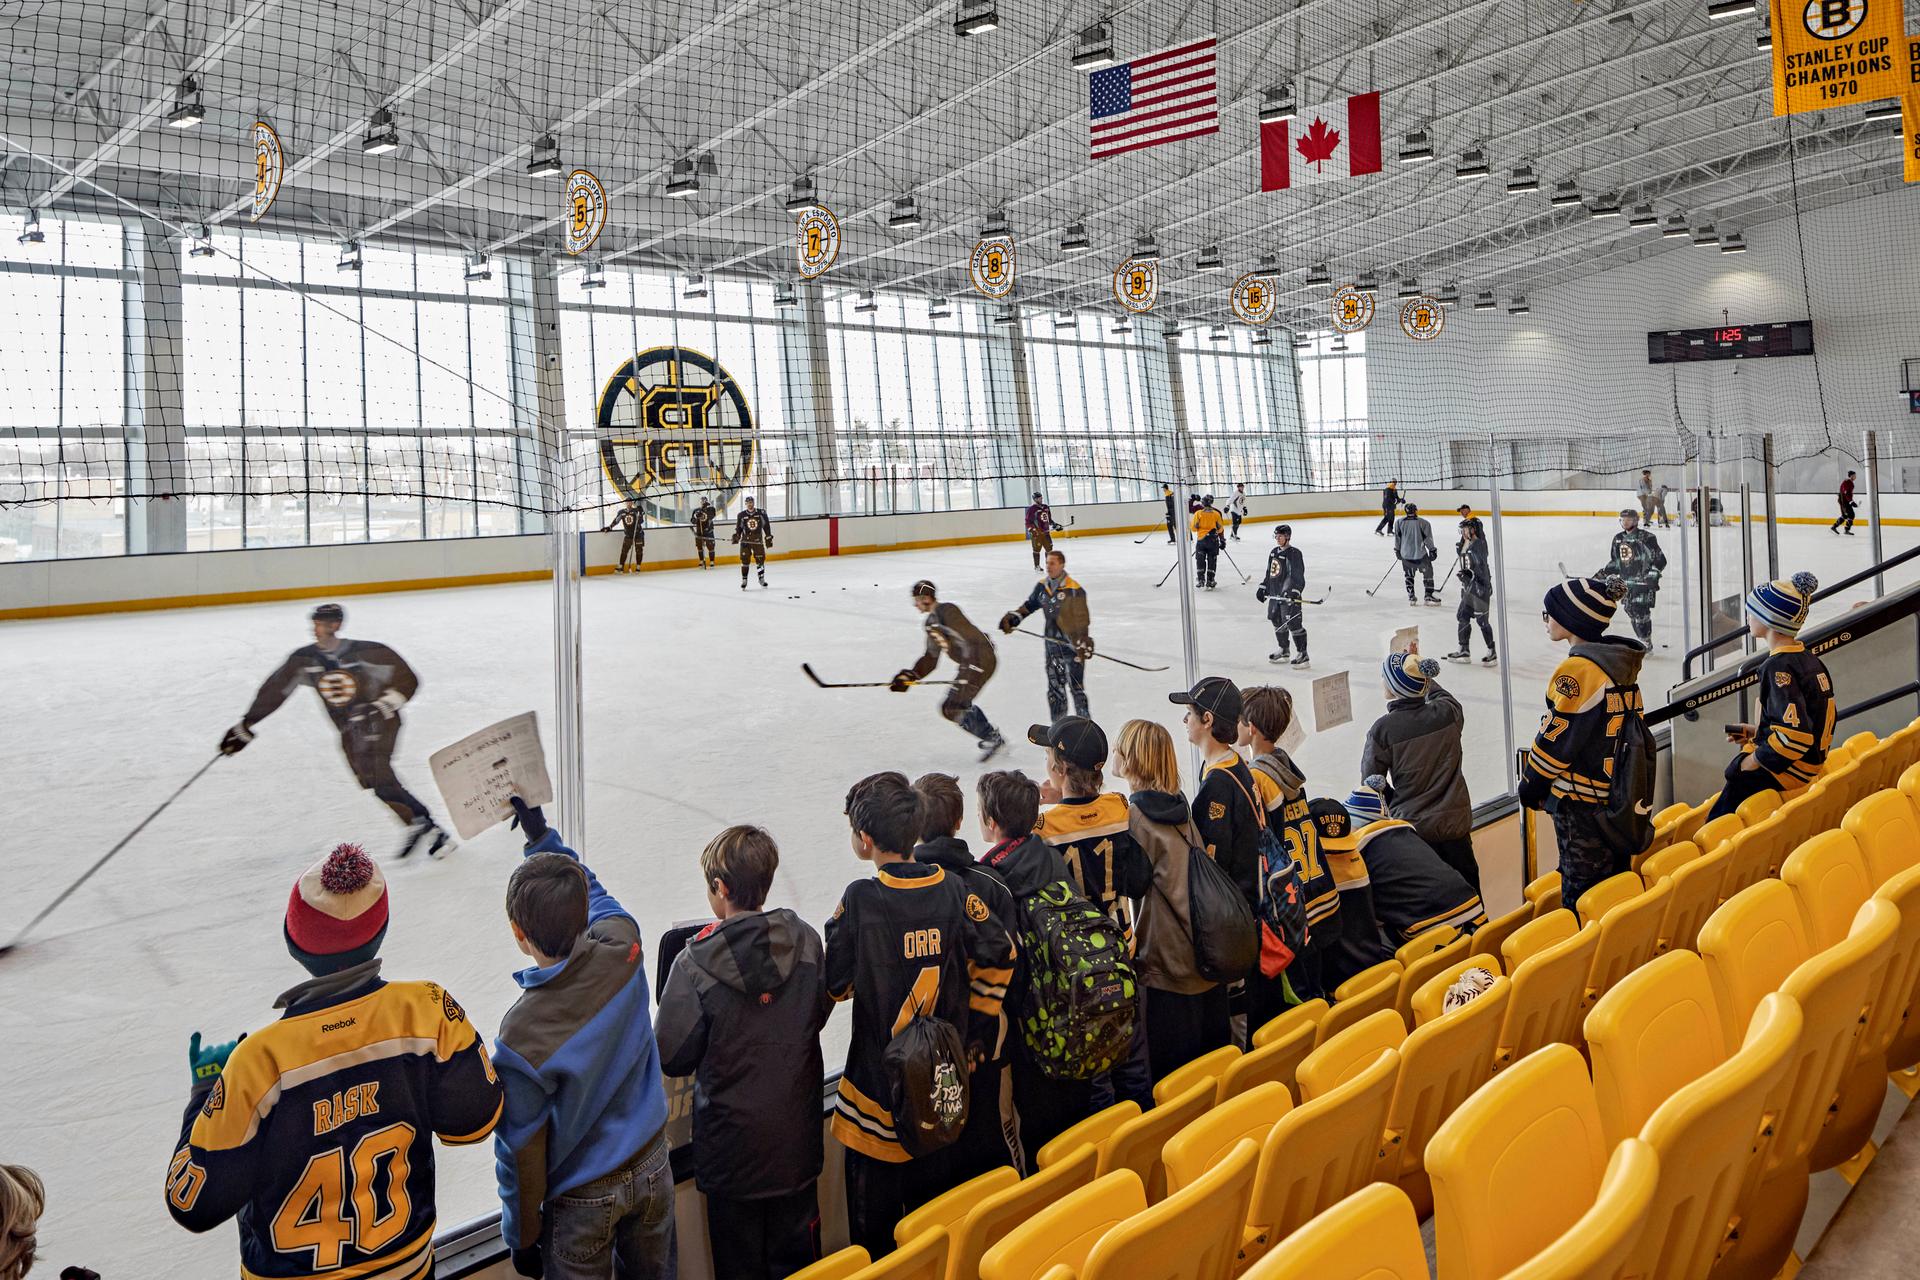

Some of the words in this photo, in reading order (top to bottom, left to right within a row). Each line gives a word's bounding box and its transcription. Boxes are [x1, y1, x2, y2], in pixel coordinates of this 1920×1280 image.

[1786, 43, 1853, 70] STANLEY
[1858, 36, 1889, 56] CUP
[1786, 55, 1892, 88] CHAMPIONS
[1820, 80, 1858, 100] 1970
[577, 204, 585, 223] 5
[812, 209, 837, 238] ESPOSITO
[811, 233, 819, 250] 7
[991, 258, 999, 273] 8
[1134, 276, 1142, 290] 9
[1250, 291, 1260, 304] 15
[1345, 304, 1355, 314] 24
[1418, 314, 1428, 323] 77
[1782, 702, 1800, 727] 4
[1541, 709, 1570, 742] 37
[1320, 814, 1345, 825] BRUINS
[904, 928, 941, 959] ORR
[321, 1017, 357, 1033] Reebok
[313, 1081, 380, 1136] RASK
[269, 1120, 416, 1271] 40
